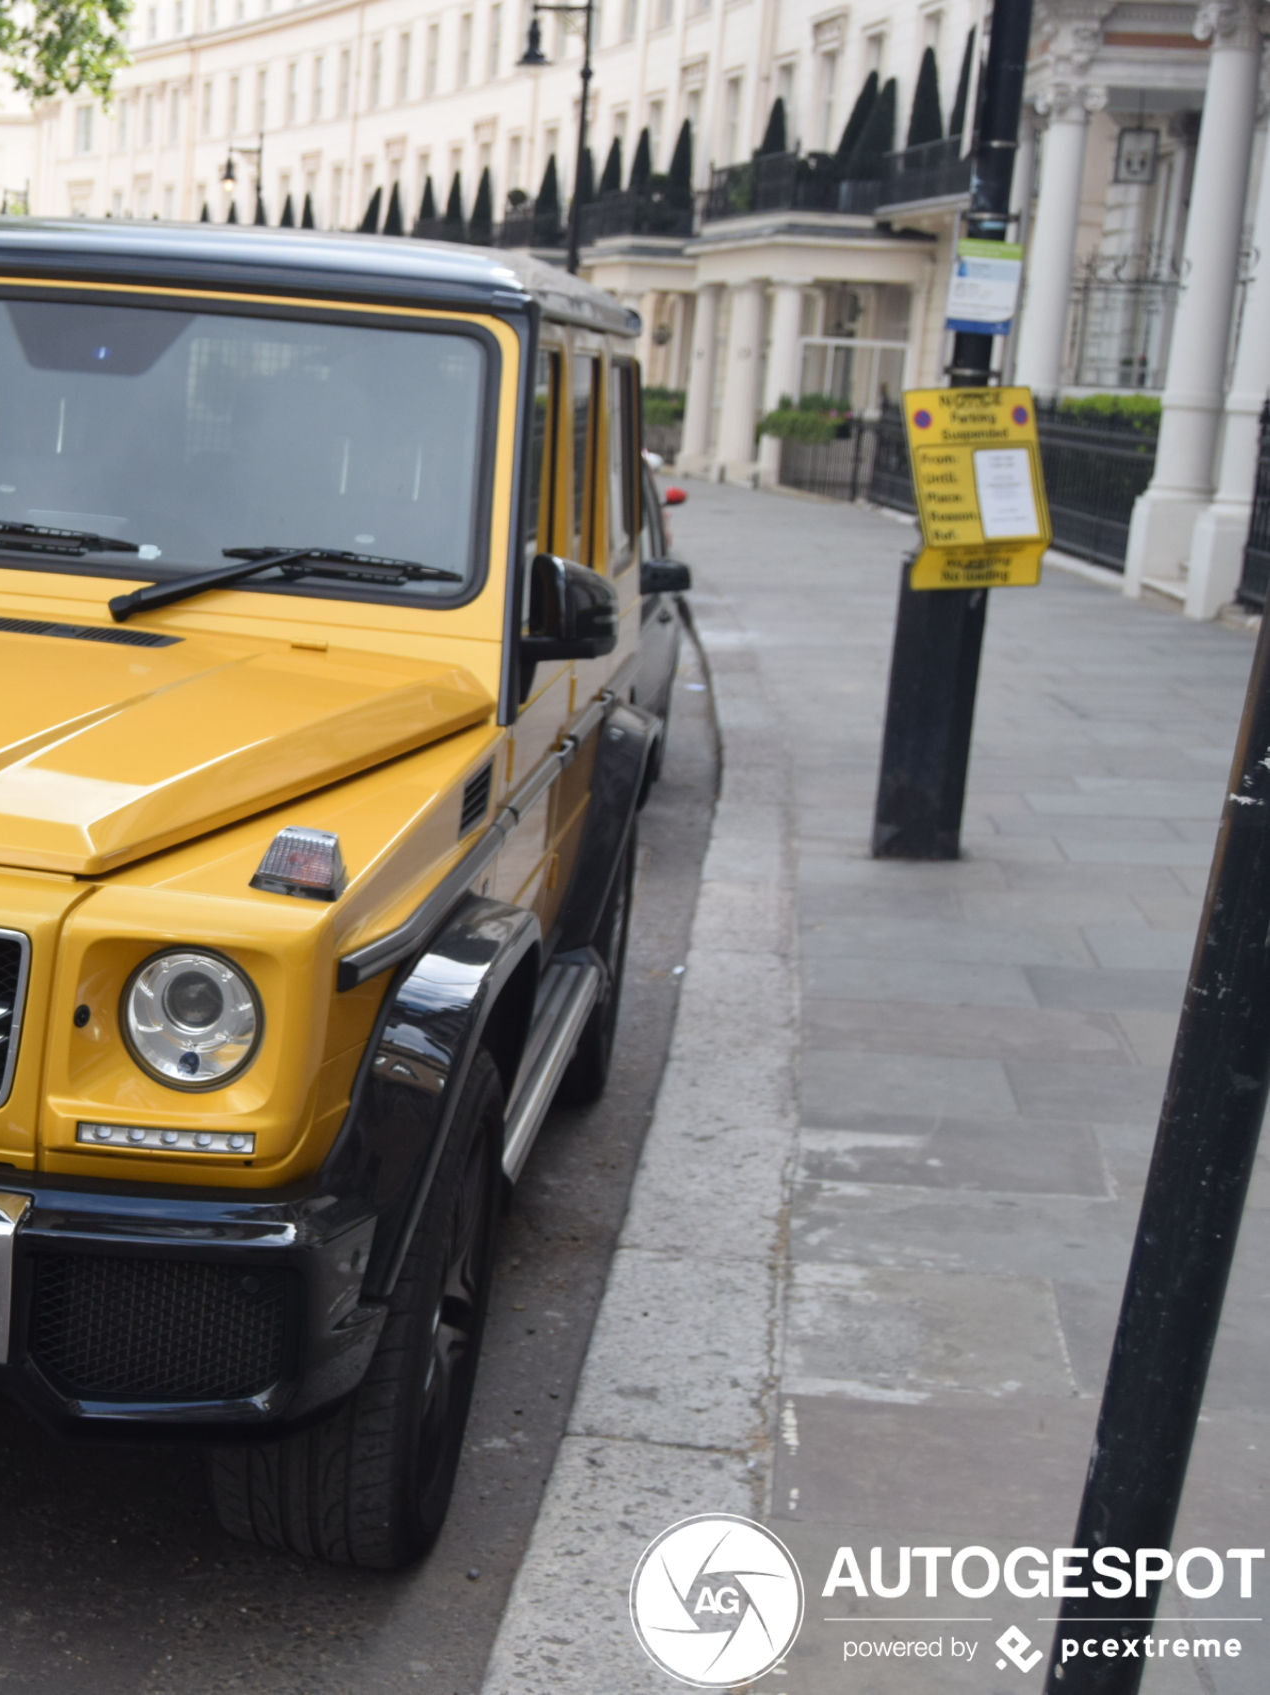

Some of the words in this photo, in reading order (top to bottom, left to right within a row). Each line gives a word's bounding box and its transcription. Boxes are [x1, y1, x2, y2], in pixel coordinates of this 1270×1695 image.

[951, 412, 996, 425] Parking
[941, 429, 1009, 441] Suspended
[966, 569, 1009, 582] loading
